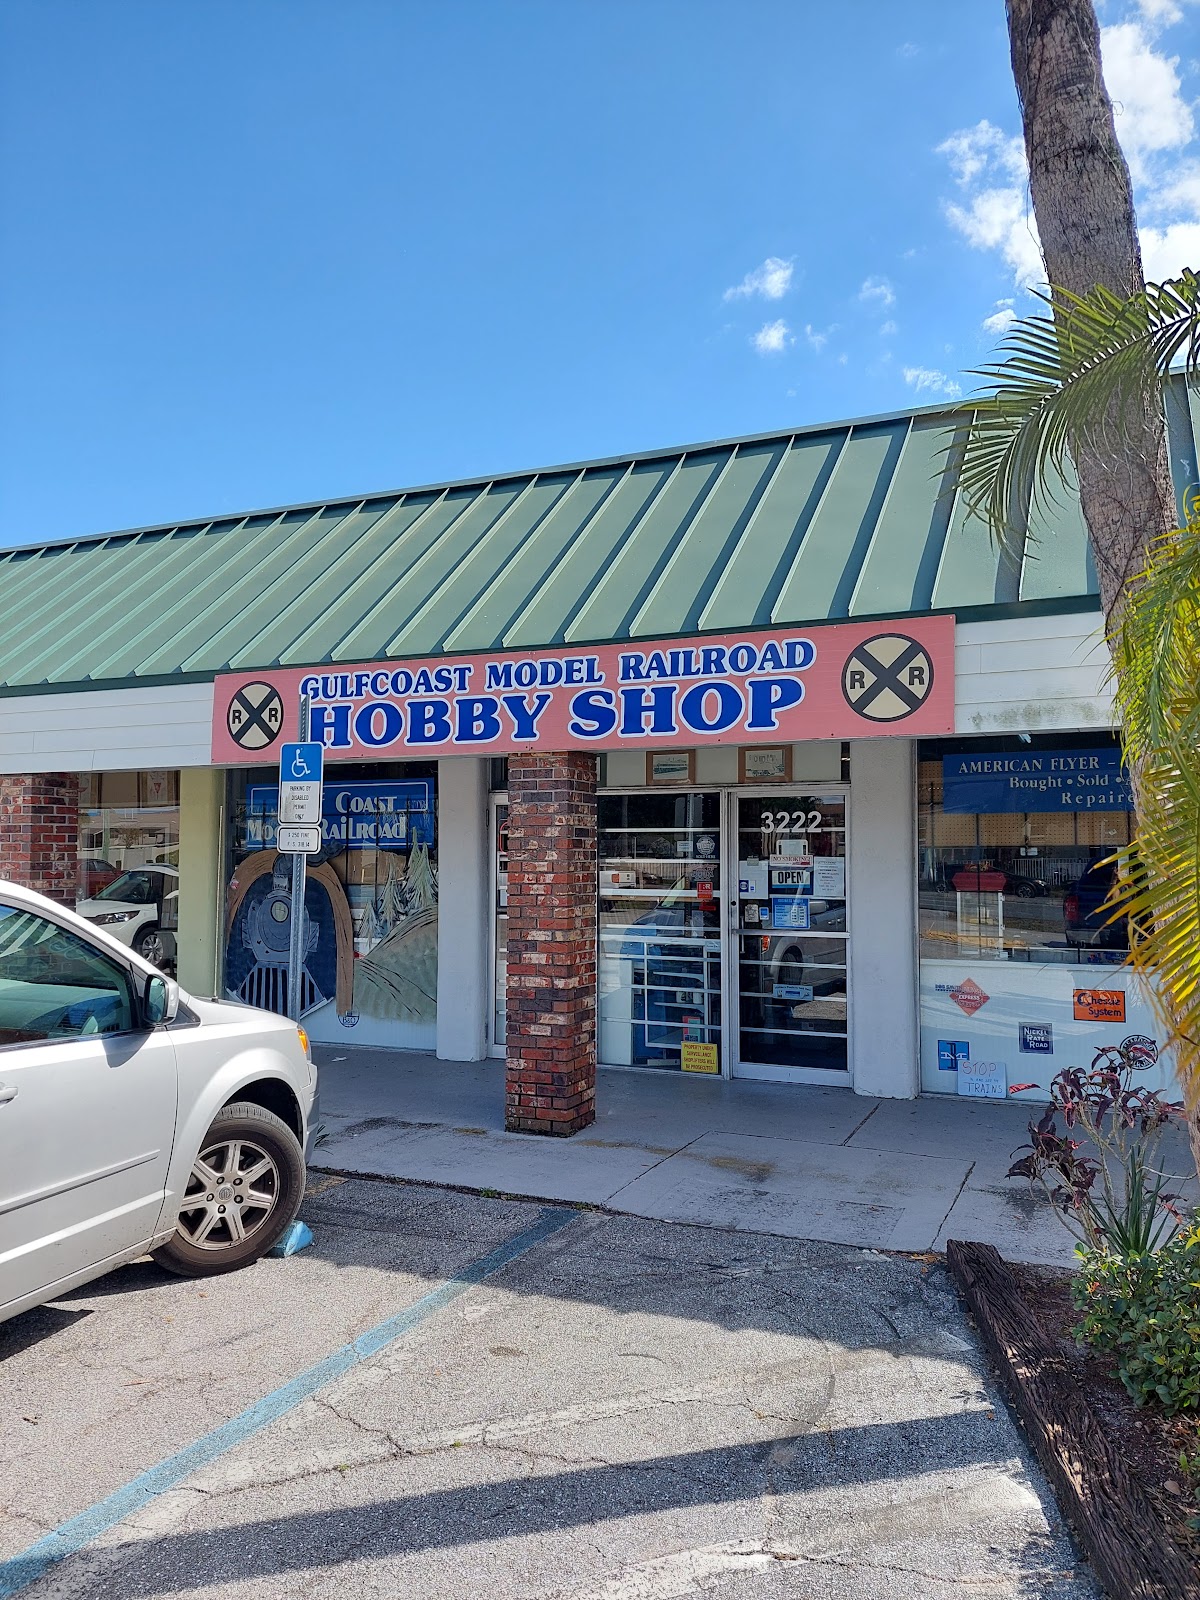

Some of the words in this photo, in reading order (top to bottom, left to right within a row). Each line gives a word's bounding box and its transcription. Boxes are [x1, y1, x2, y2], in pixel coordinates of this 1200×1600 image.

[300, 664, 472, 700] GULFCOAST
[487, 656, 604, 691] MODEL
[617, 637, 817, 684] RAILROAD
[310, 693, 552, 749] HOBBY
[568, 675, 805, 740] SHOP
[959, 758, 1043, 774] AMERICAN
[1051, 756, 1100, 771] FLYER
[1010, 776, 1062, 791] Bought
[1077, 774, 1109, 787] Sold
[760, 811, 822, 834] 3222
[777, 871, 804, 884] OPEN
[1088, 1007, 1122, 1018] System
[1029, 1041, 1049, 1049] ROAD
[963, 1062, 997, 1077] STOP
[963, 1081, 1003, 1094] TRAINS
